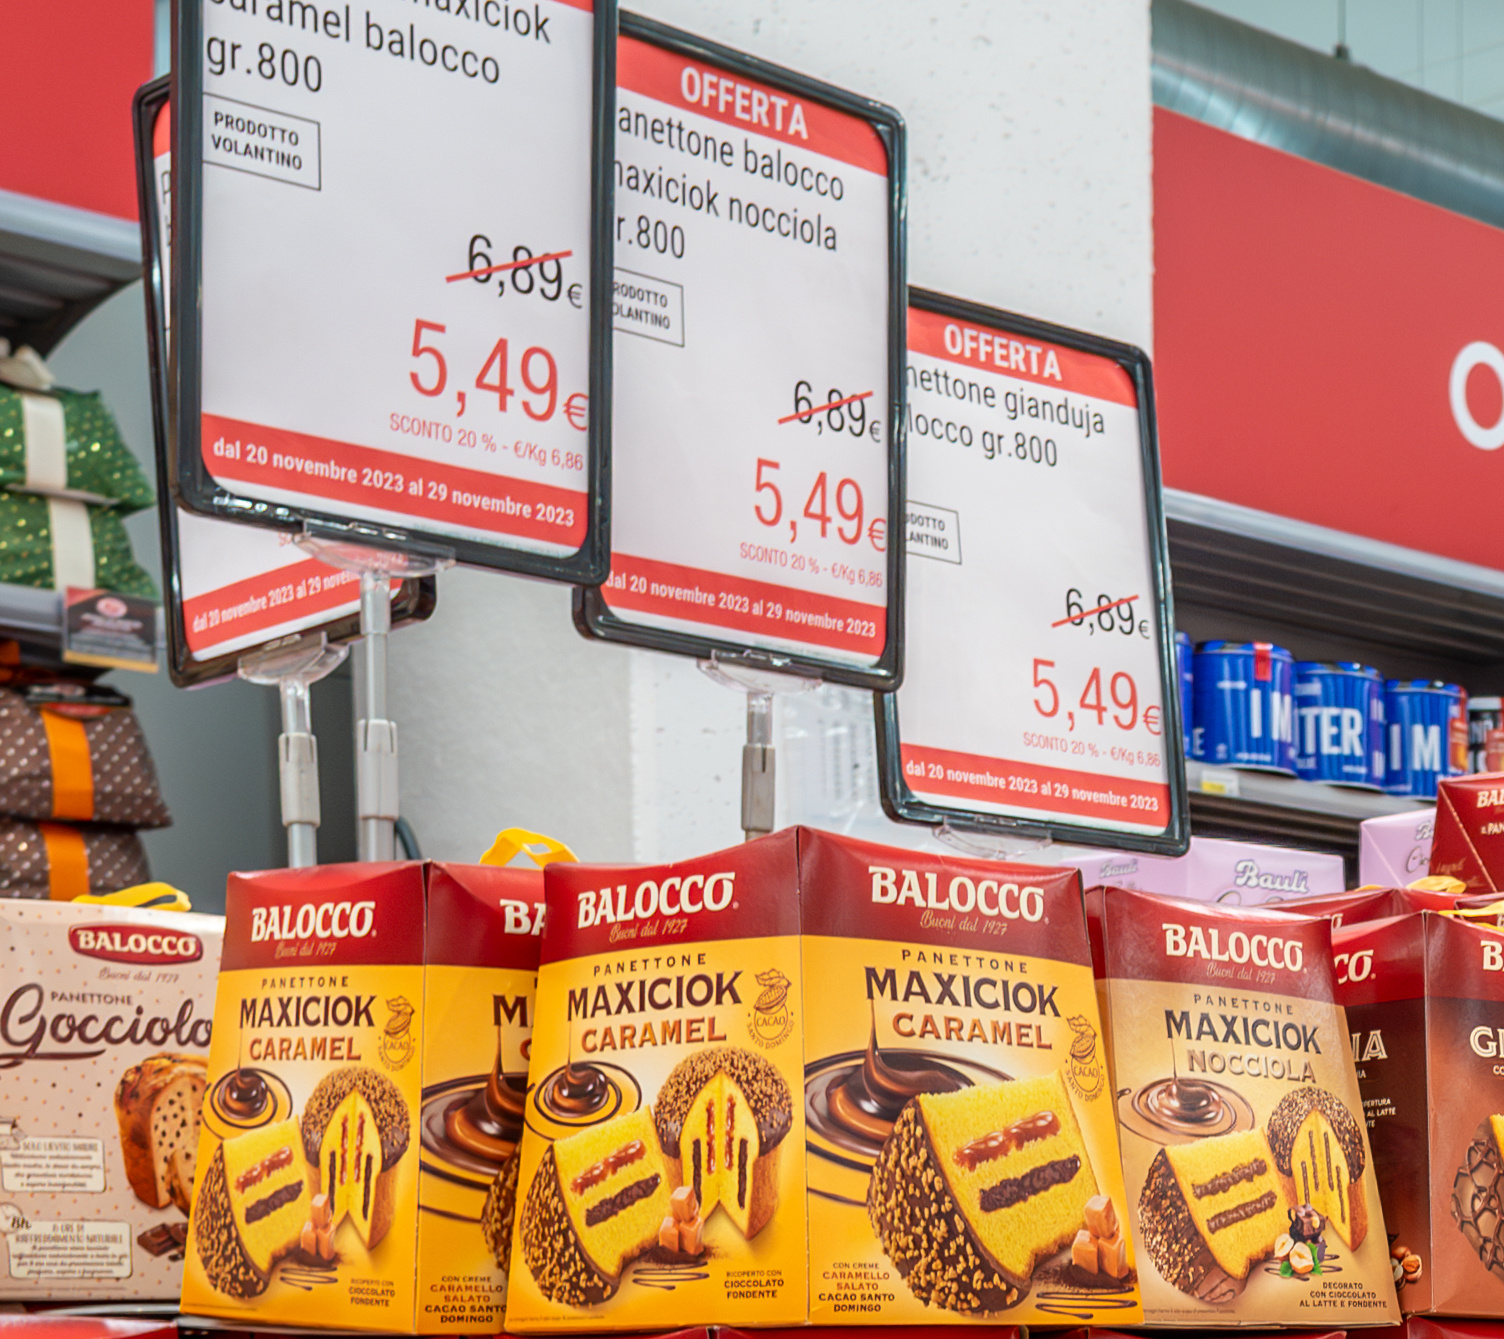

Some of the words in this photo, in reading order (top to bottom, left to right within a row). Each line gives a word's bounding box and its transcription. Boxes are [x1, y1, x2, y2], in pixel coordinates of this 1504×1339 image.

[206, 36, 322, 93] gr.800
[366, 11, 500, 84] balocco
[681, 67, 808, 139] OFFERTA
[213, 110, 299, 146] PRODOTTO
[211, 134, 303, 170] VOLANTINO
[618, 106, 734, 168] anettone
[744, 138, 844, 201] balocco
[616, 215, 685, 259] r.800
[729, 195, 837, 252] nocciola
[945, 323, 1062, 381] OFFERTA
[907, 365, 996, 408] nettone
[1005, 388, 1104, 438] gianduja
[390, 413, 452, 443] SCONTO
[457, 429, 477, 449] 20
[551, 451, 584, 471] 6,86
[983, 430, 1057, 467] gr.800
[212, 436, 241, 460] dal
[245, 444, 269, 465] 20
[272, 452, 358, 484] novembre
[362, 467, 404, 493] 2023
[408, 481, 424, 495] al
[428, 482, 448, 502] 29
[452, 489, 532, 518] novembre
[536, 501, 575, 527] 2023
[869, 866, 1043, 922] BALOCCO
[1234, 859, 1309, 893] Bauli
[577, 872, 735, 929] BALOCCO
[593, 953, 706, 976] PANETTONE
[902, 949, 1028, 974] PANETTONE
[1162, 923, 1302, 973] BALOCCO
[568, 971, 743, 1022] MAXICIOK
[864, 966, 1062, 1018] MAXICIOK
[1194, 994, 1294, 1015] PANETTONE
[581, 1016, 726, 1052] CARAMEL
[892, 1012, 1052, 1050] CARAMEL
[1165, 1009, 1321, 1055] MAXICIOK
[1187, 1048, 1316, 1083] NOCCIOLA
[724, 1277, 784, 1289] CIOCCOLATO
[727, 1288, 778, 1299] FONDENTE
[823, 1272, 890, 1280] CARAMELLO
[837, 1283, 879, 1291] SALATO
[1322, 1282, 1363, 1290] DECORATO
[1328, 1290, 1376, 1299] CIOCCOLATO
[819, 1293, 857, 1302] CACAO
[860, 1293, 895, 1302] SANTO
[833, 1303, 881, 1312] DOMINGO
